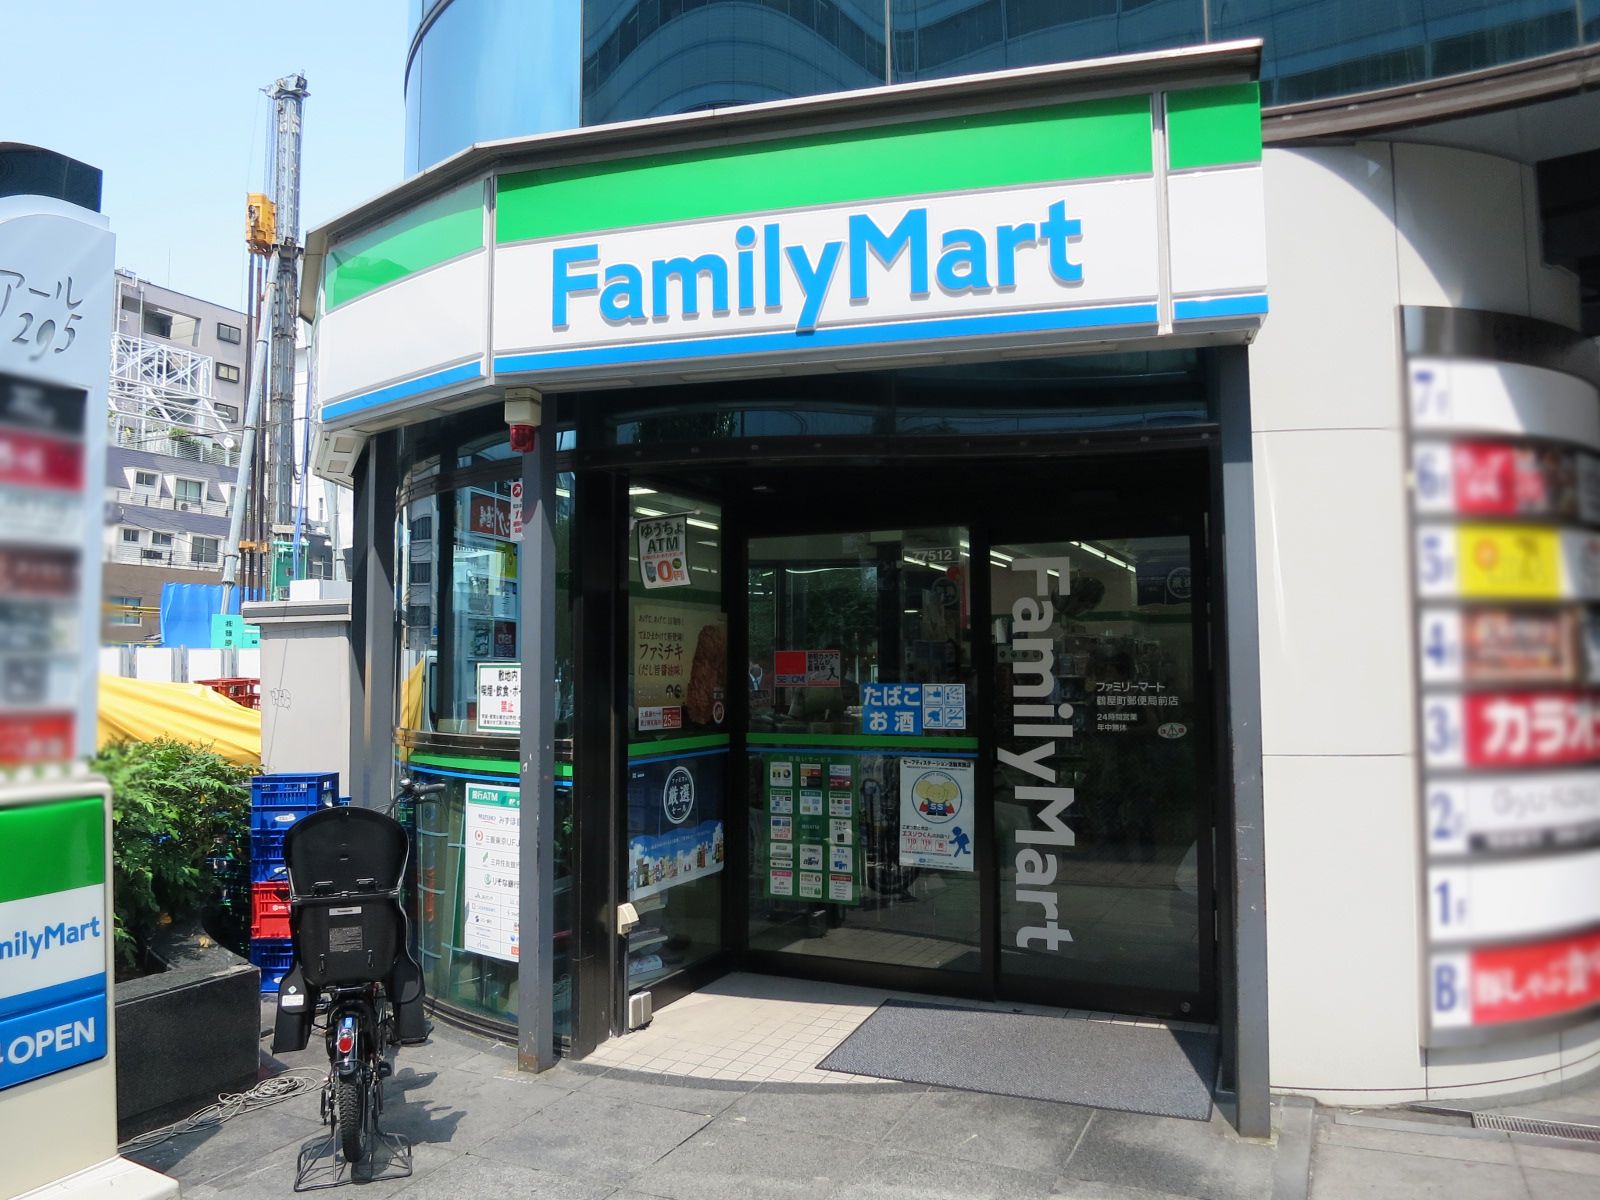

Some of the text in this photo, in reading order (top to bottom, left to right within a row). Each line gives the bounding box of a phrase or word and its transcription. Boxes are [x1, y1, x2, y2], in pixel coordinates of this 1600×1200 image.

[552, 199, 1083, 335] FamilyMart
[12, 312, 83, 362] 295
[640, 520, 684, 538] ゆうちょ
[647, 536, 680, 553] ATM
[912, 549, 952, 561] 77512
[639, 642, 684, 661] ファミチキ
[480, 684, 522, 698] 喫煙・飲食・ポ
[1095, 681, 1166, 693] ファミリーマート
[863, 685, 920, 707] たばこ
[500, 699, 514, 713] 禁止
[869, 710, 914, 733] お酒
[1096, 713, 1138, 721] 24時間営業
[1096, 723, 1128, 732] 年中無休
[997, 556, 1075, 951] FamilyMart
[471, 790, 498, 802] 銀行ATM
[668, 783, 690, 807] 厳選
[929, 803, 944, 811] SS
